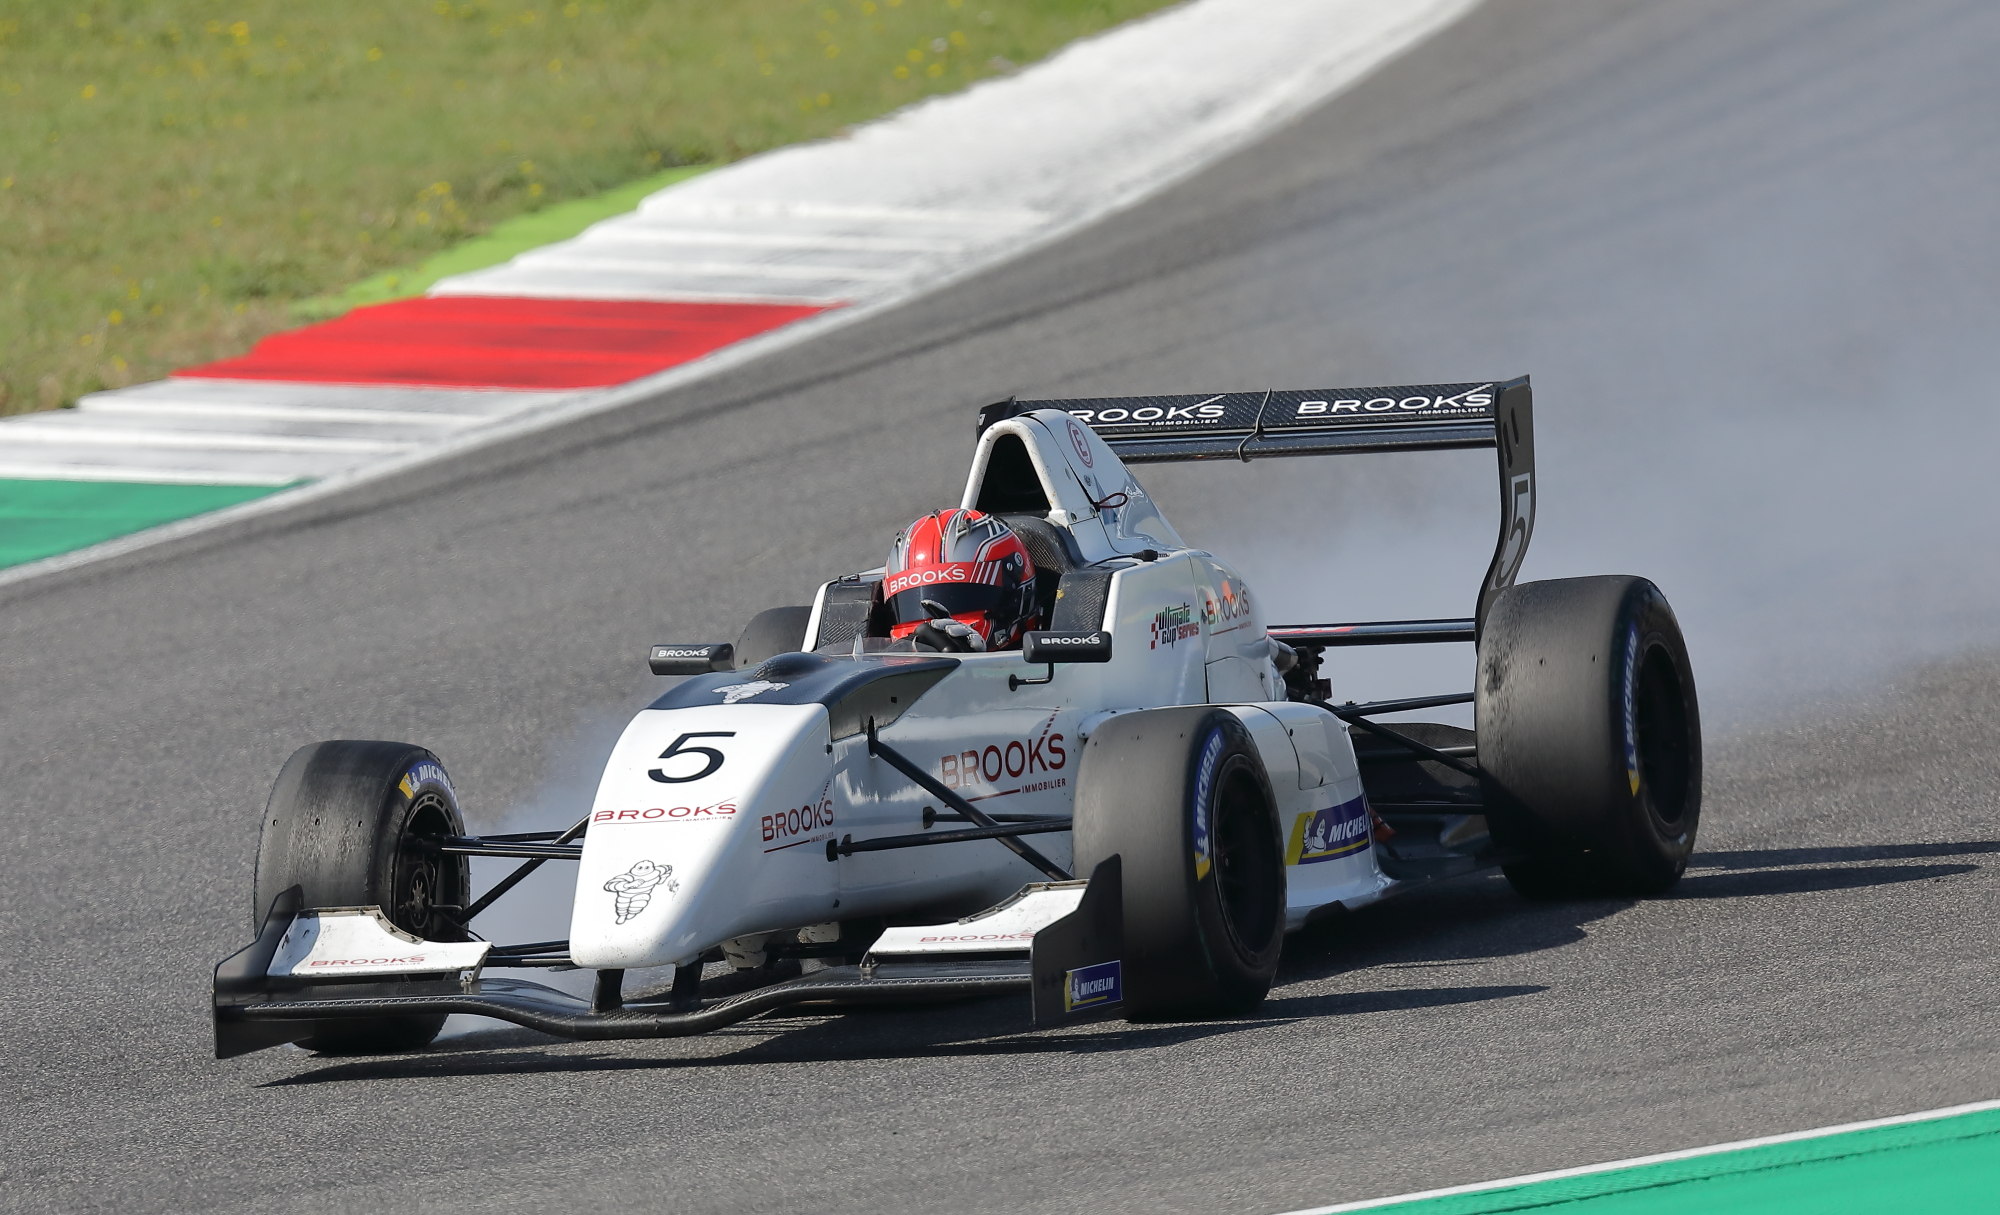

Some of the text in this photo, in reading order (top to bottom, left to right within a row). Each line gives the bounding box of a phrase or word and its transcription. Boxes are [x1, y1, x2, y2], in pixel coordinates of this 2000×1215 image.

[1068, 395, 1226, 423] ROOKS
[1297, 384, 1494, 415] BROOKS
[1418, 407, 1486, 415] IMMOBILIER
[1151, 418, 1219, 427] IMMOBILIER
[890, 564, 966, 594] BROOKS
[1206, 586, 1250, 625] BROOKS
[658, 647, 710, 657] BROOKS
[1041, 634, 1100, 645] BROOKS
[1624, 630, 1638, 745] MICHELIN
[648, 731, 737, 784] 5
[942, 722, 1066, 790] BROOKS
[1022, 778, 1066, 794] IMMOBILIER
[1197, 733, 1222, 832] MICHELIN
[594, 798, 737, 822] BROOKS
[762, 793, 834, 841] BROOKS
[1328, 812, 1369, 843] MICHEL
[920, 931, 1035, 942] BROOKS
[310, 955, 426, 967] BROOKS
[1080, 976, 1115, 995] MICHELIN
